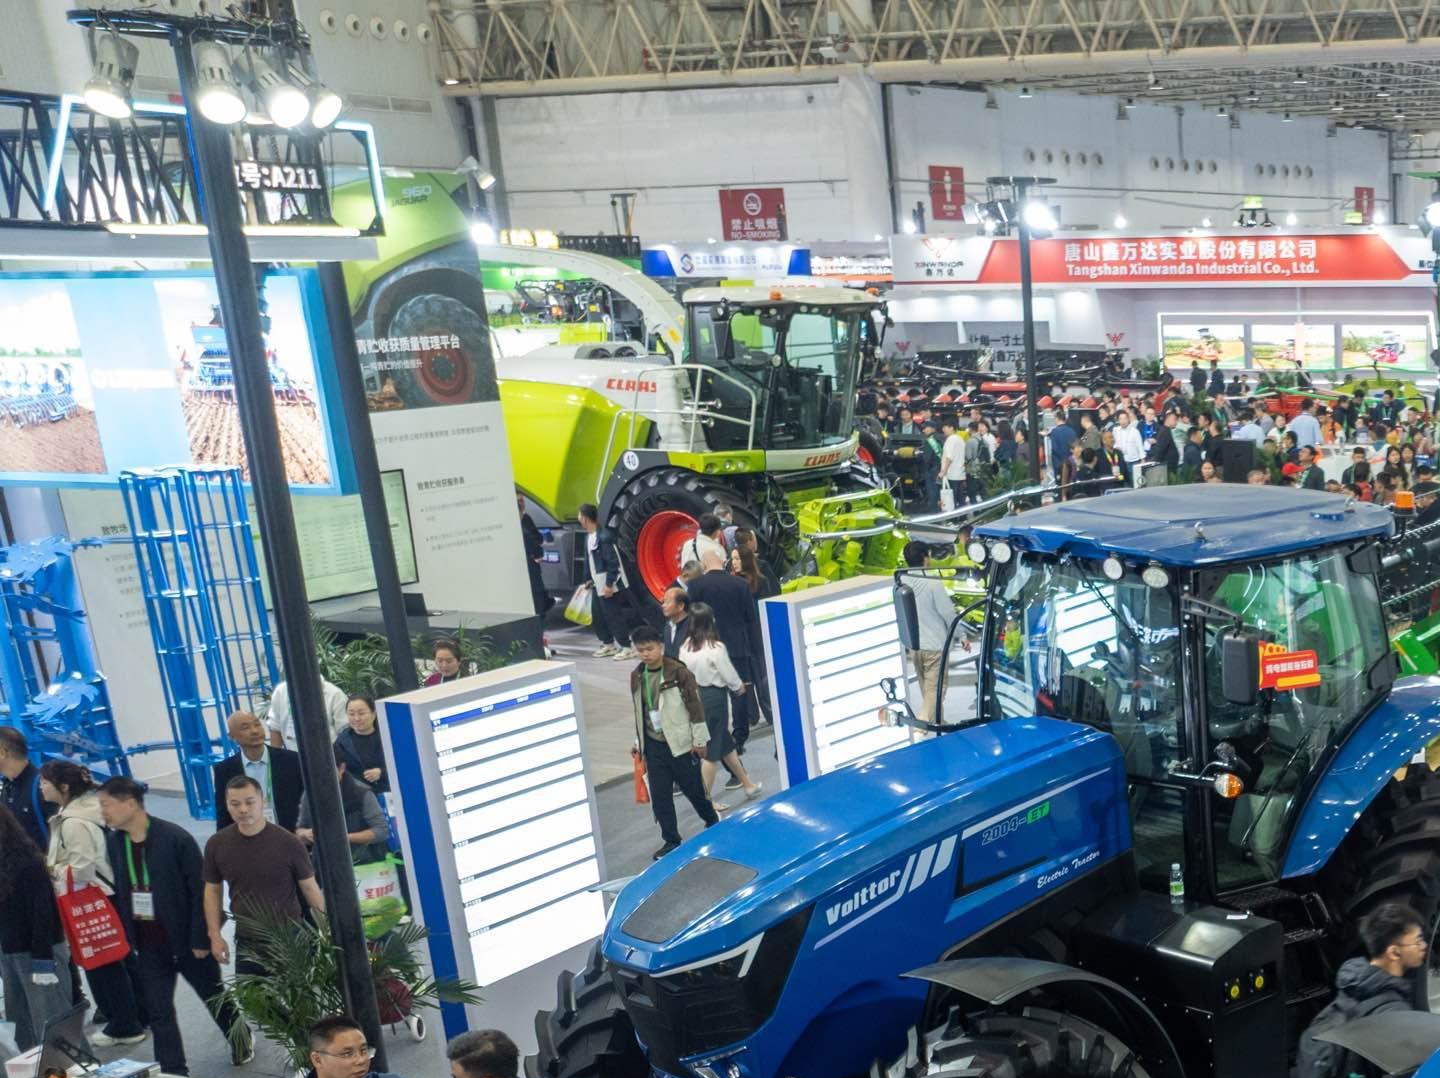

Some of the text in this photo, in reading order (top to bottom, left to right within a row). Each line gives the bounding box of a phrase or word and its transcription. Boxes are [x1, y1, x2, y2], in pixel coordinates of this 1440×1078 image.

[731, 217, 778, 231] 禁止吸烟
[1064, 239, 1318, 262] 唐山鑫万达实业股份有限公司
[1066, 263, 1320, 278] Tangshan Xinwanda Industrial Co., Ltd.
[606, 378, 657, 393] CLAAS
[625, 455, 637, 467] 40
[803, 451, 841, 467] CLAAS
[1037, 850, 1101, 889] Electric Tractor
[825, 868, 901, 926] Volttor
